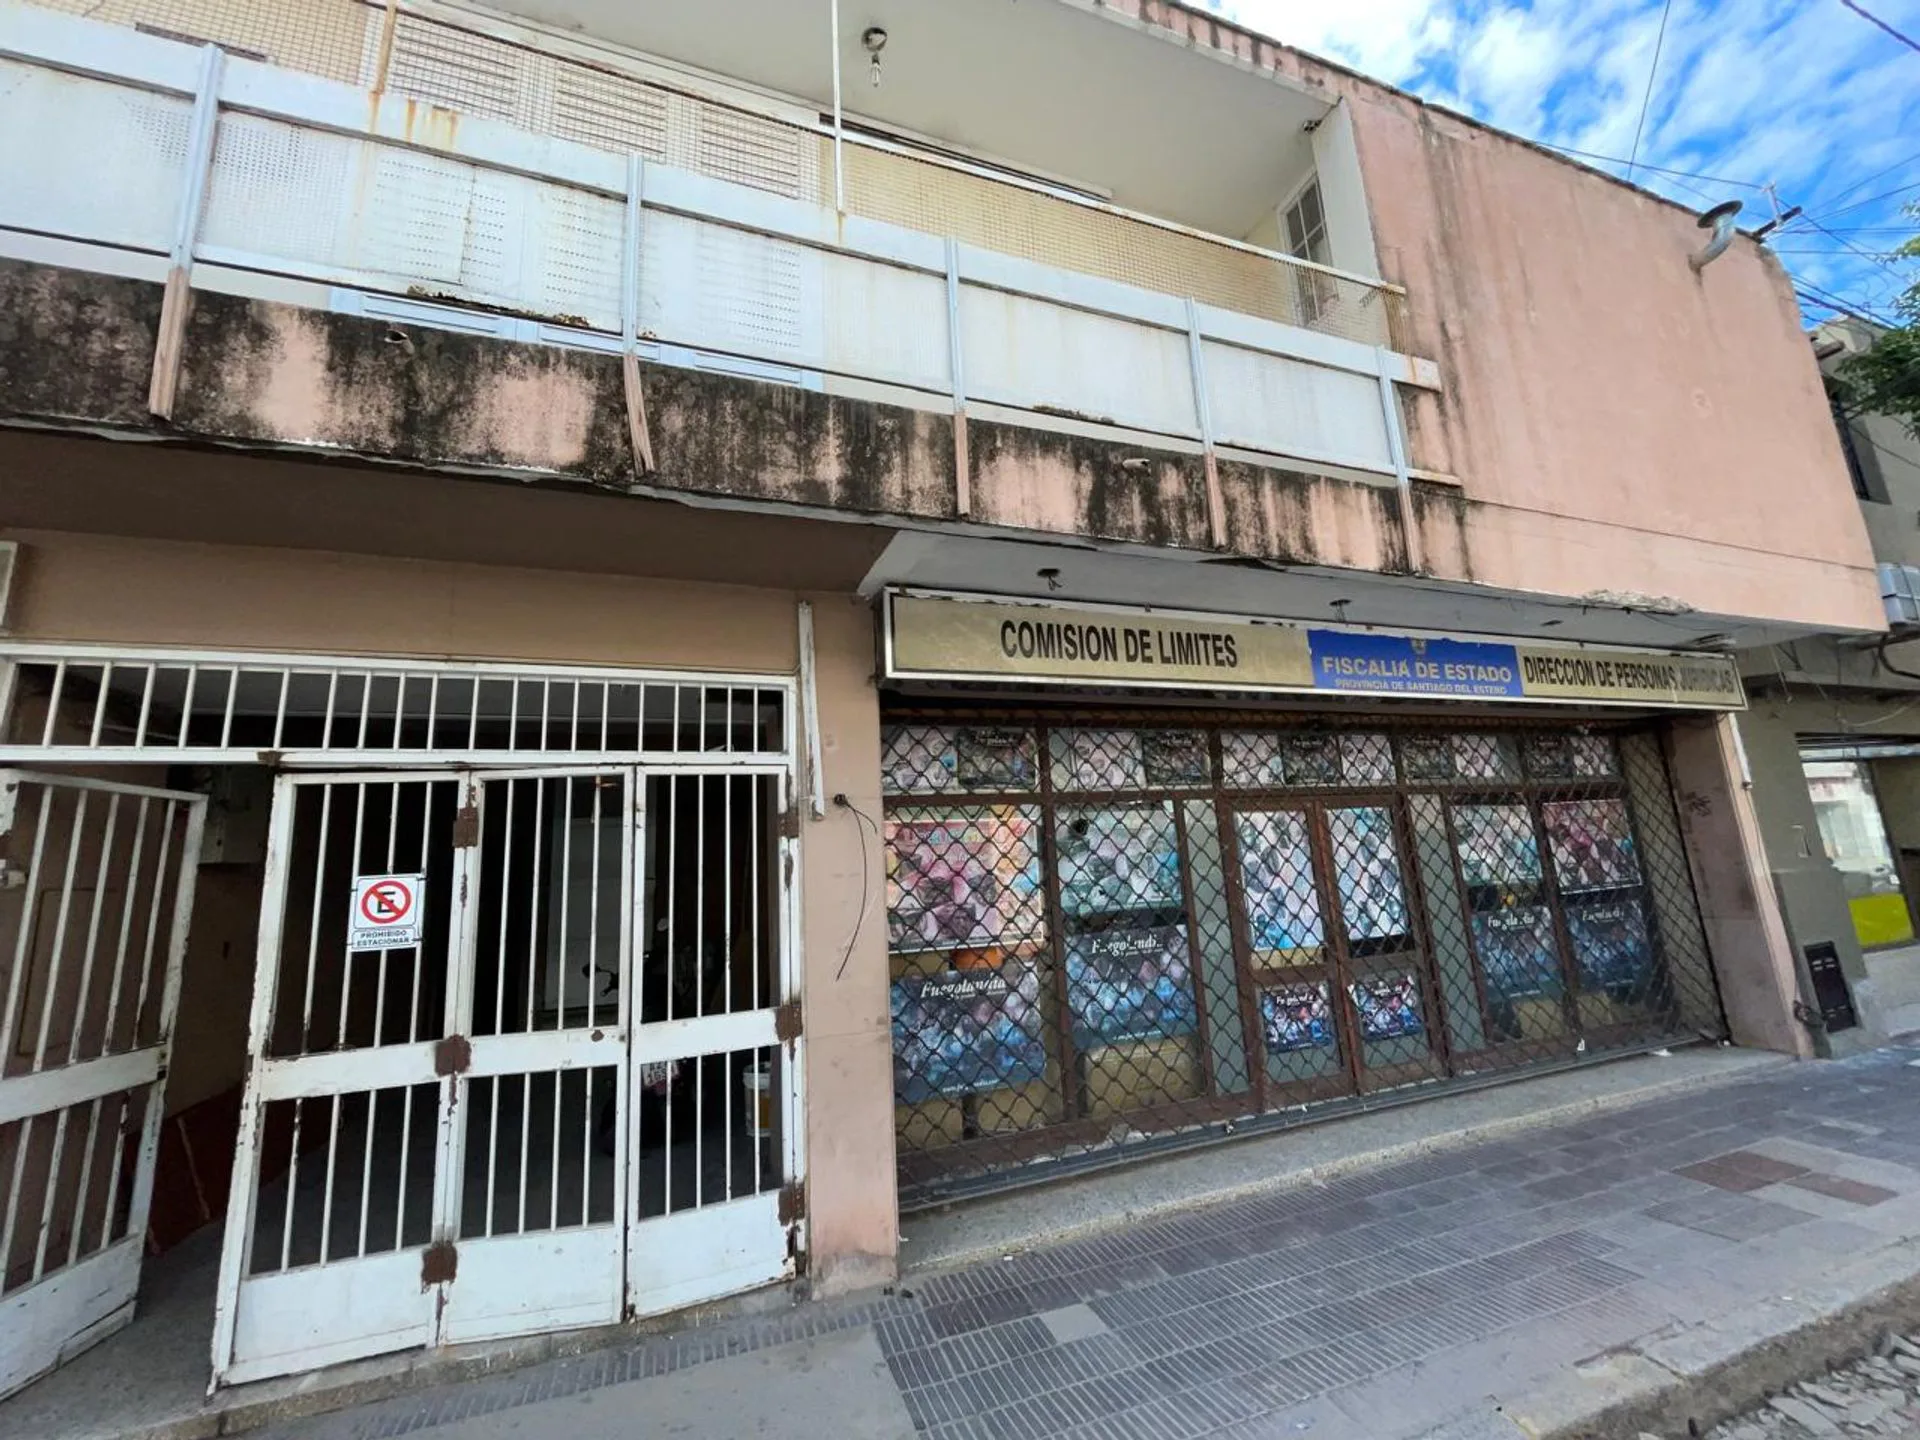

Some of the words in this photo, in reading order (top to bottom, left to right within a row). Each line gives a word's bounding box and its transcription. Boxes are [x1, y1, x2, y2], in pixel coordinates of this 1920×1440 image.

[1001, 619, 1118, 661] COMISION
[1123, 628, 1153, 664] DE
[1158, 631, 1238, 668] LIMITES
[1415, 662, 1440, 679] DE
[1445, 664, 1512, 683] ESTADO
[1523, 656, 1597, 687] DIRECCION
[1595, 661, 1615, 687] DE
[1615, 662, 1677, 691] PERSONAS
[1335, 678, 1389, 689] PROVINCIA
[1391, 680, 1404, 690] DE
[1407, 681, 1453, 693] SANTIAGO
[1454, 683, 1471, 693] DEL
[357, 937, 409, 946] ESTACIONAR
[360, 929, 407, 939] PROHIBIDO
